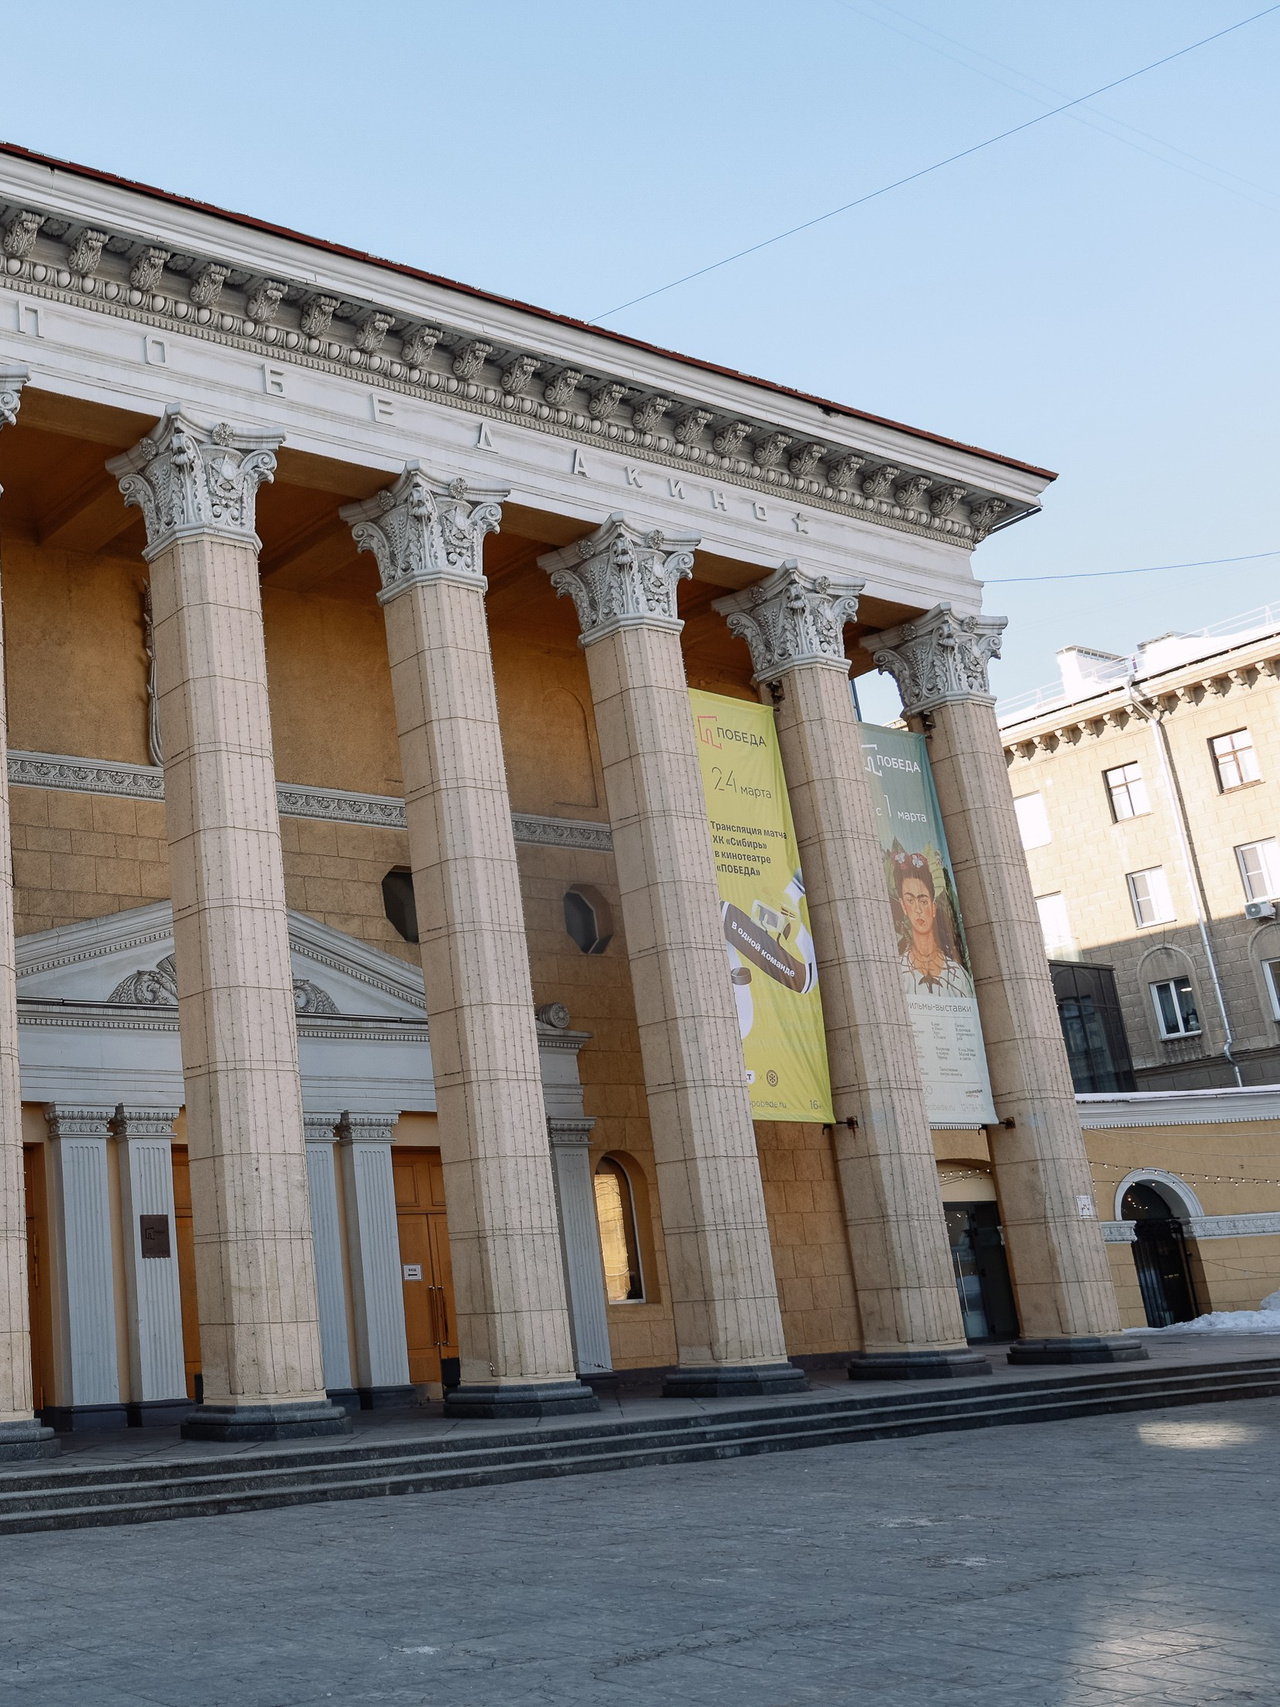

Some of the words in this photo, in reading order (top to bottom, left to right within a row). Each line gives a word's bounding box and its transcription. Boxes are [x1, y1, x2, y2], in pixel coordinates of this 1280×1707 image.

[717, 727, 766, 747] ПОБЕДА
[876, 755, 921, 773] ПОБЕДА
[711, 766, 737, 793] 24
[741, 787, 771, 799] марта
[898, 811, 927, 823] марта
[710, 821, 762, 836] Трансляция
[763, 829, 787, 839] матча
[712, 835, 724, 844] ХК
[726, 837, 767, 850] «Сибирь»
[721, 851, 771, 864] кинотеатре
[717, 864, 761, 877] «ПОБЕДА»
[737, 927, 761, 952] одной
[761, 949, 795, 977] команде
[908, 1002, 971, 1012] ильмы-выставки
[750, 1100, 786, 1108] pobede.ru
